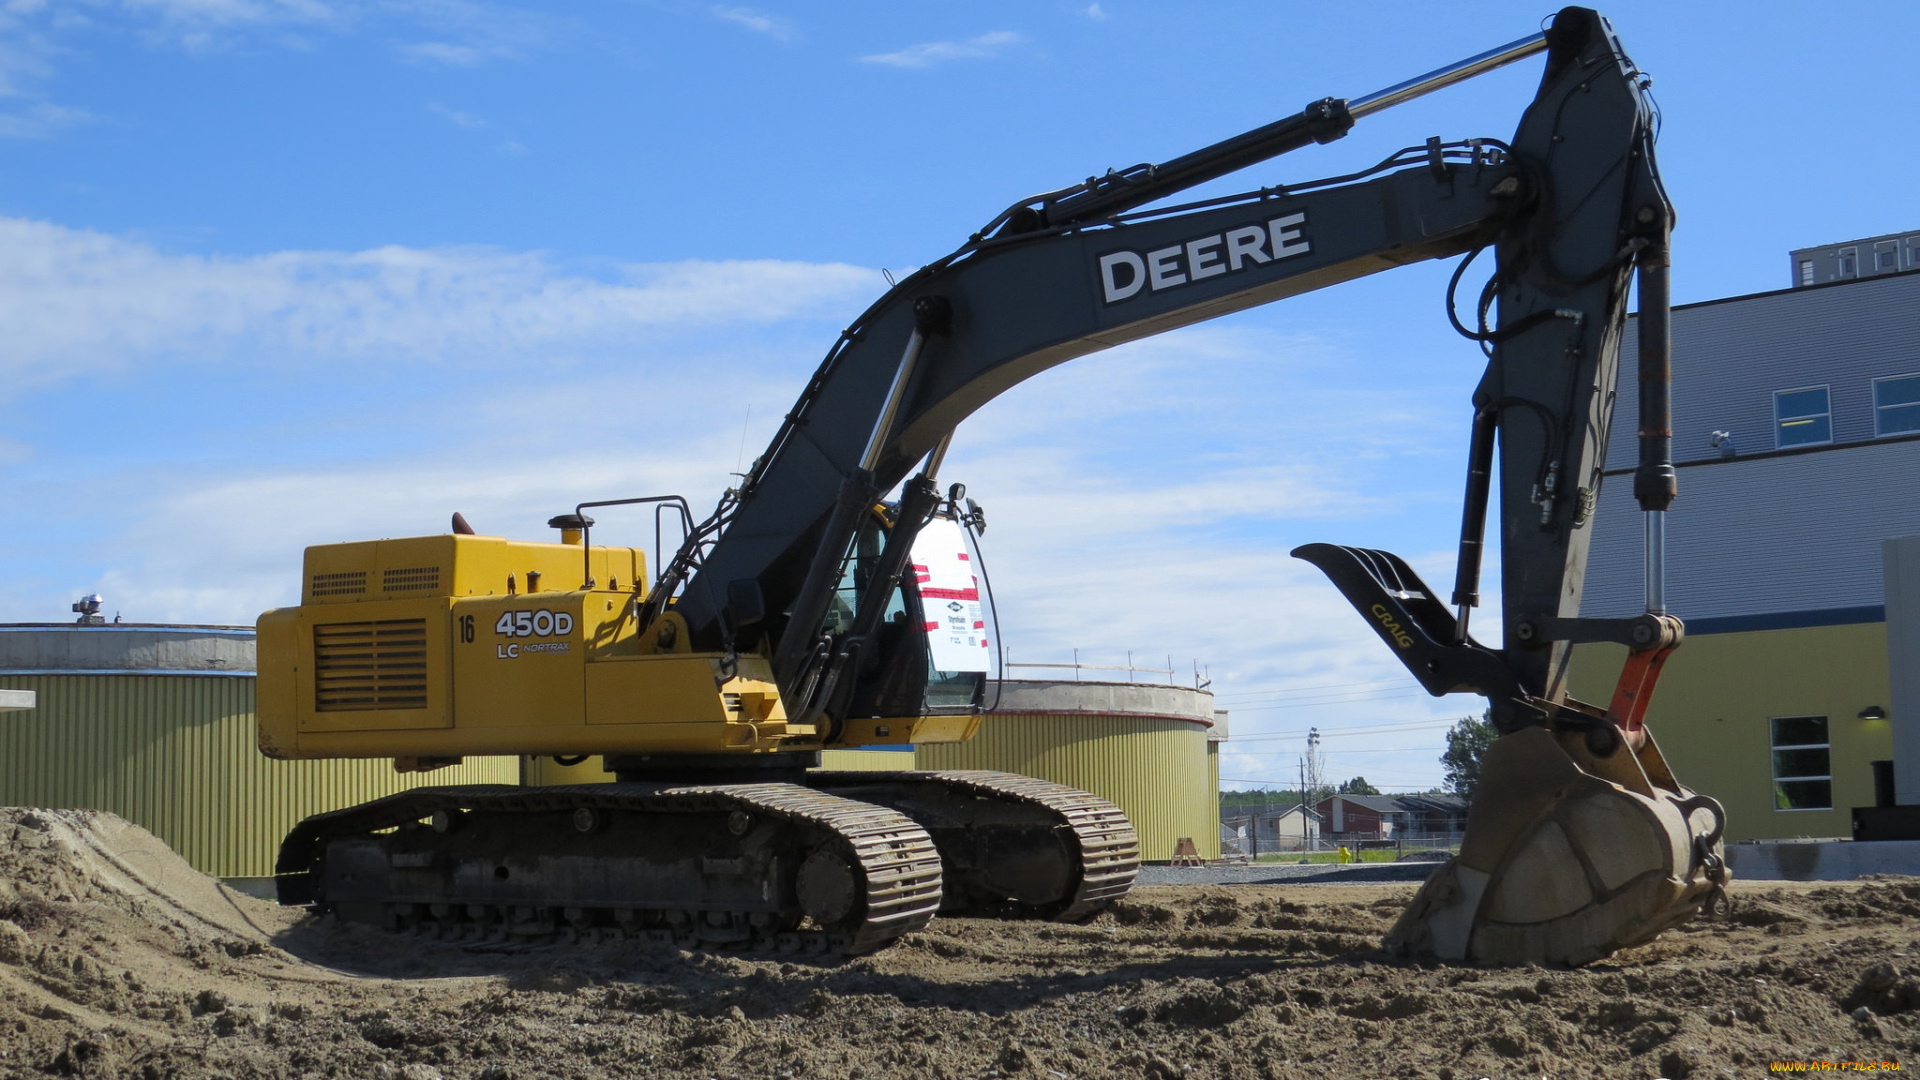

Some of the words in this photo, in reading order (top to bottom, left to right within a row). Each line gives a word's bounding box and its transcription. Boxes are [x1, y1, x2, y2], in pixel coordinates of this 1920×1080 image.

[1099, 211, 1310, 303] DEERE
[459, 614, 475, 643] 16
[495, 609, 574, 638] 450D
[1371, 603, 1415, 649] CRAIG
[496, 642, 519, 659] LC
[522, 642, 571, 653] NORTRAX
